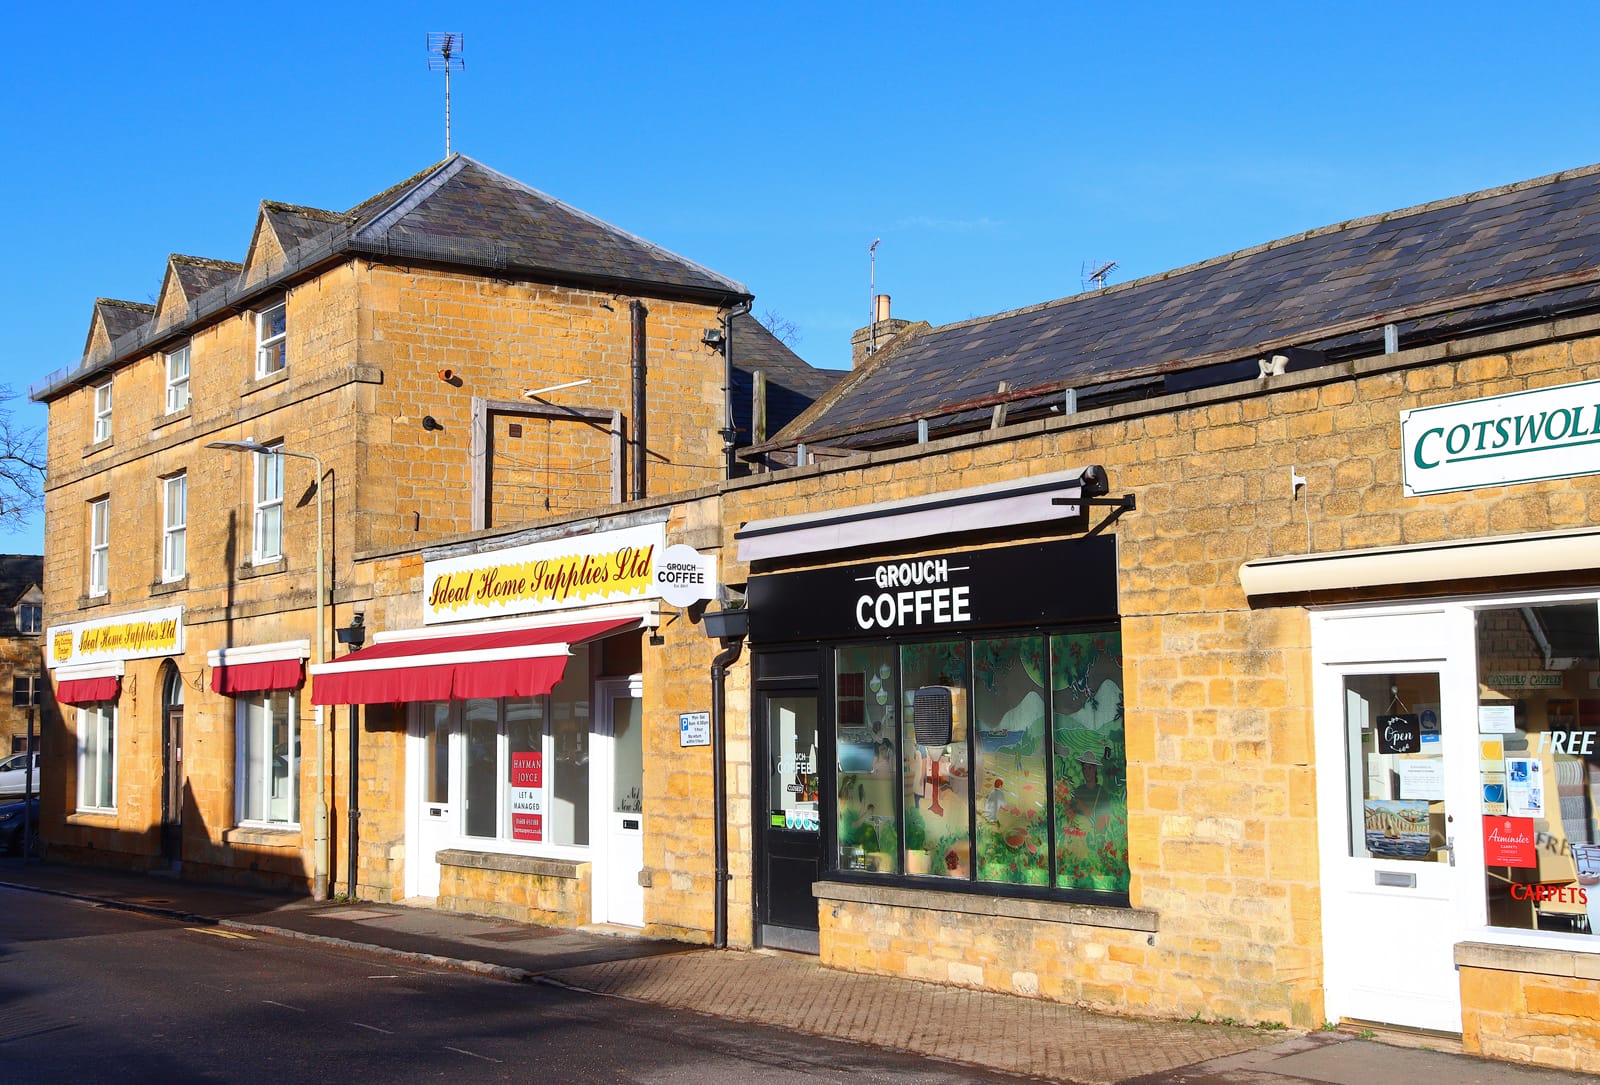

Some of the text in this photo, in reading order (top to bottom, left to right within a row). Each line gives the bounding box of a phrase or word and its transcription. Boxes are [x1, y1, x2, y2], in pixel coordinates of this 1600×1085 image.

[429, 544, 655, 606] Ideal Home Supplies Ltd
[666, 562, 696, 571] GROUCH
[875, 559, 948, 588] GROUCH
[658, 571, 704, 584] COFFEE
[856, 586, 971, 630] COFFEE
[79, 617, 178, 651] Ideal Home Supplies Ltd
[682, 719, 688, 730] P
[1384, 725, 1414, 746] Open
[1537, 730, 1597, 755] FREE
[513, 759, 541, 769] HAYMAN
[517, 773, 538, 783] JOYCE
[528, 792, 533, 800] &
[514, 802, 540, 811] MANAGED
[1487, 827, 1530, 844] Axminster
[1509, 883, 1588, 905] CARPETS
